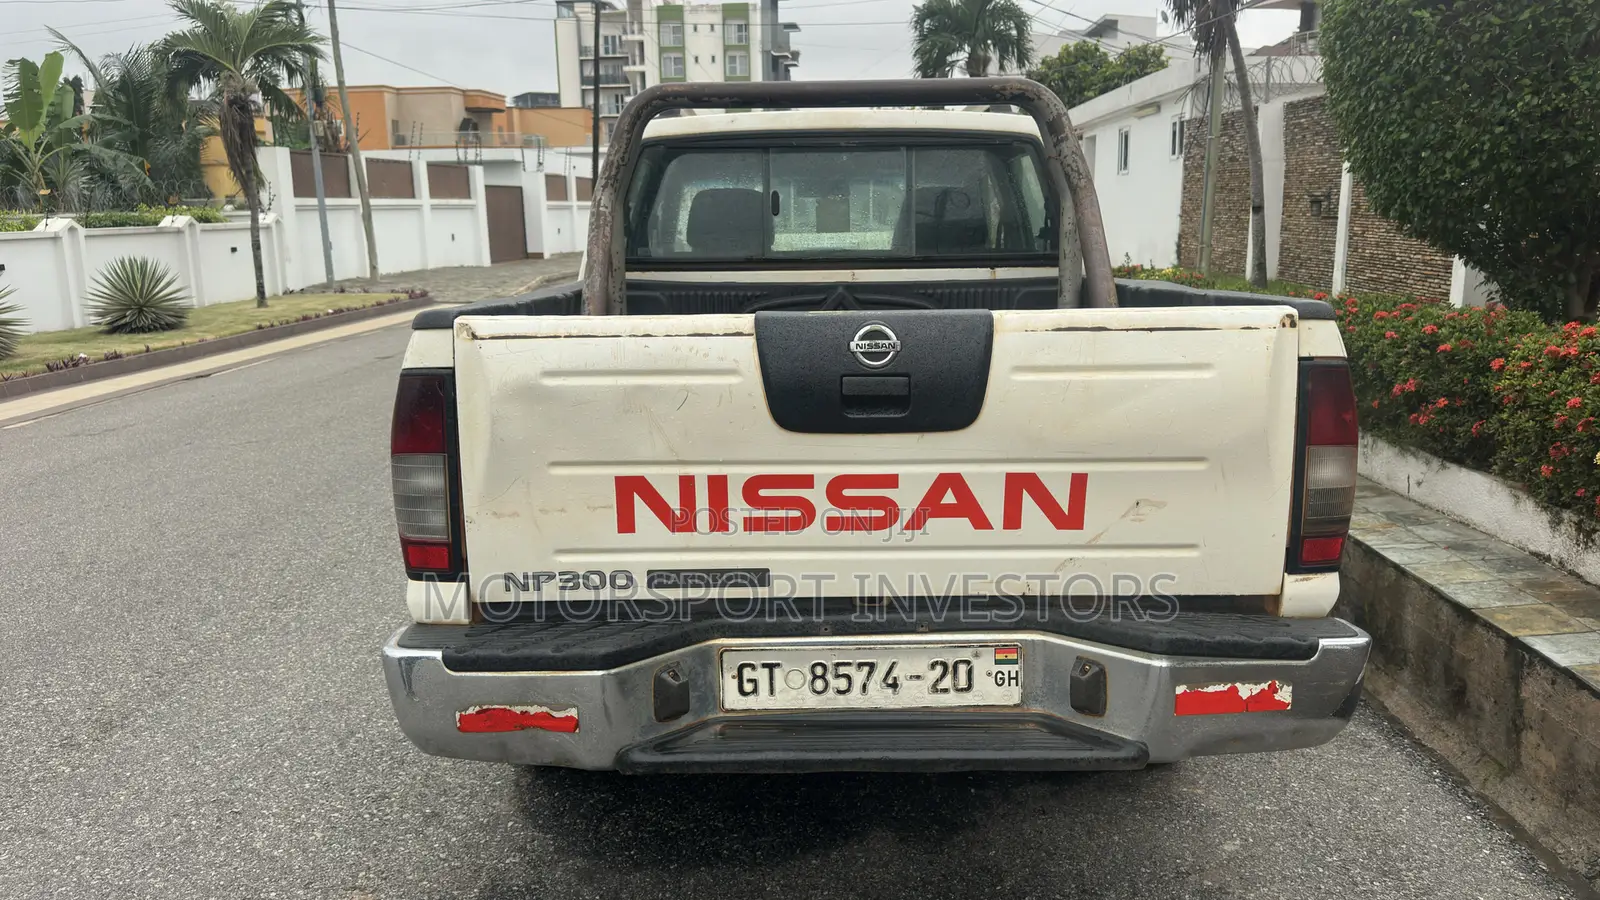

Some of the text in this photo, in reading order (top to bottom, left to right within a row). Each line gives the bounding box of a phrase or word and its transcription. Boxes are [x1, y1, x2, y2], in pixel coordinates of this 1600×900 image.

[855, 342, 896, 350] NISSAN
[614, 472, 1088, 534] NISSAN
[503, 569, 634, 592] NP300
[737, 660, 781, 697] GT
[994, 670, 1019, 687] GH
